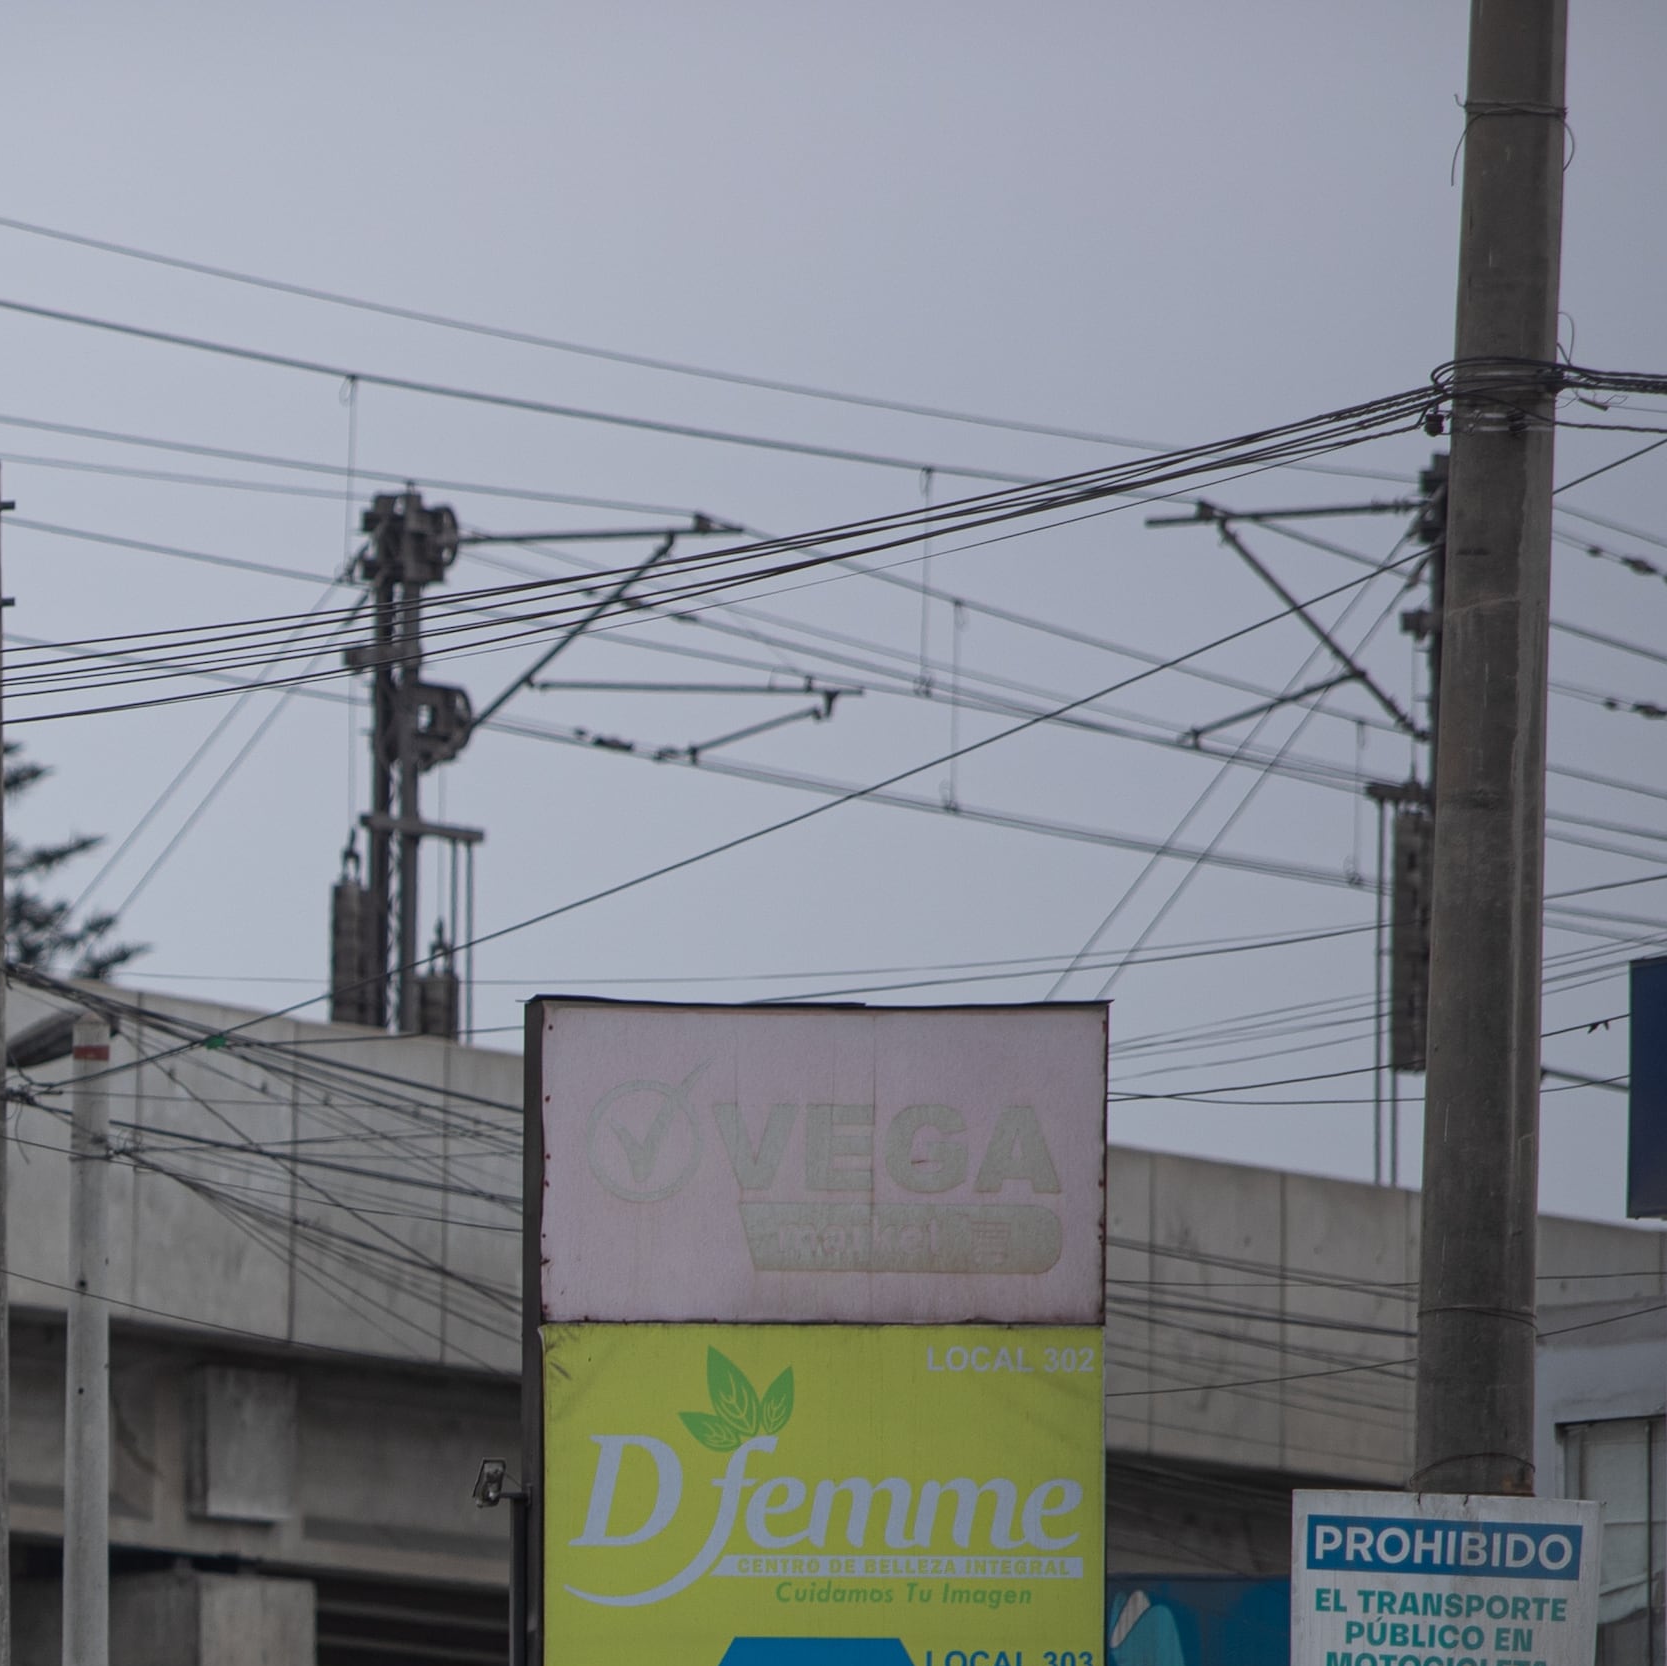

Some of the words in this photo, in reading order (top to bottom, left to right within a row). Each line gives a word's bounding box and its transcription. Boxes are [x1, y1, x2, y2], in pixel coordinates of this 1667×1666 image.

[712, 1102, 1062, 1194] VEGA
[926, 1346, 1033, 1373] LOCAL
[1044, 1346, 1095, 1373] 302
[1314, 1524, 1573, 1571] PROHIBIDO
[736, 1558, 820, 1574] CENTRO
[827, 1558, 857, 1574] DE
[865, 1559, 957, 1575] BELLEZA
[966, 1560, 1070, 1576] INTEGRAL
[775, 1580, 894, 1604] Cuidamos
[906, 1582, 933, 1604] Tu
[942, 1583, 1032, 1610] Imagen
[1315, 1588, 1348, 1613] EL
[1357, 1589, 1568, 1622] TRANSPORTE
[1345, 1616, 1485, 1650] PÚBLICO
[1494, 1627, 1533, 1652] EN
